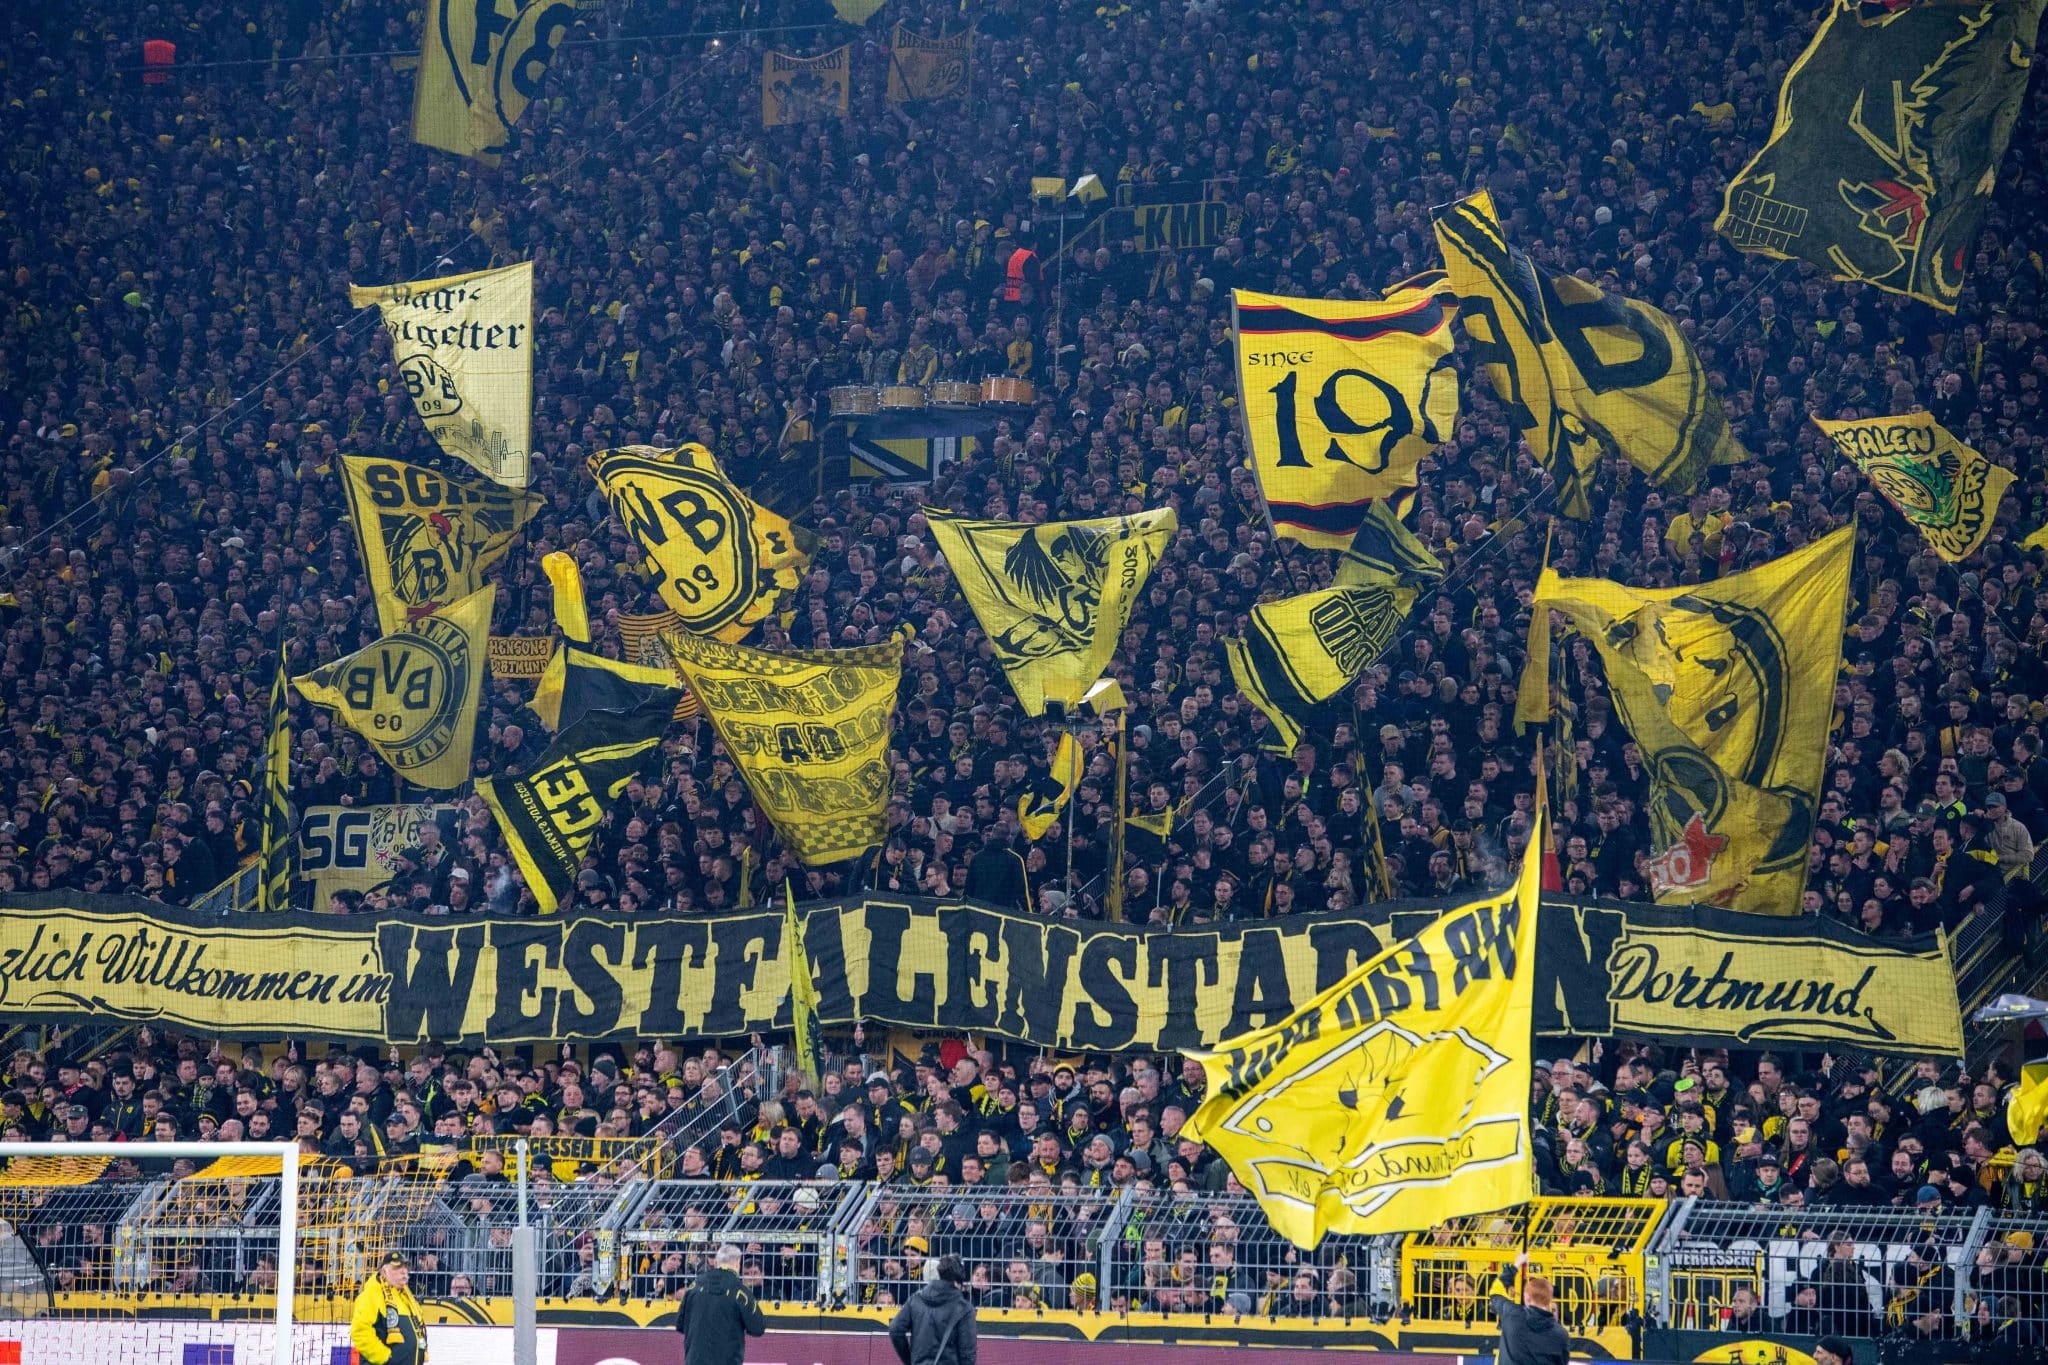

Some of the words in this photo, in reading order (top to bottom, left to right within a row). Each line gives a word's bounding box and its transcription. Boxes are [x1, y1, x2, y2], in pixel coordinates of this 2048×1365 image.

[422, 400, 442, 412] 09
[674, 563, 720, 604] 09
[96, 927, 336, 1005] Willkommen
[338, 952, 393, 1005] im
[1607, 943, 1880, 1020] Dortmund
[475, 1136, 594, 1160] UNVEGESSEN
